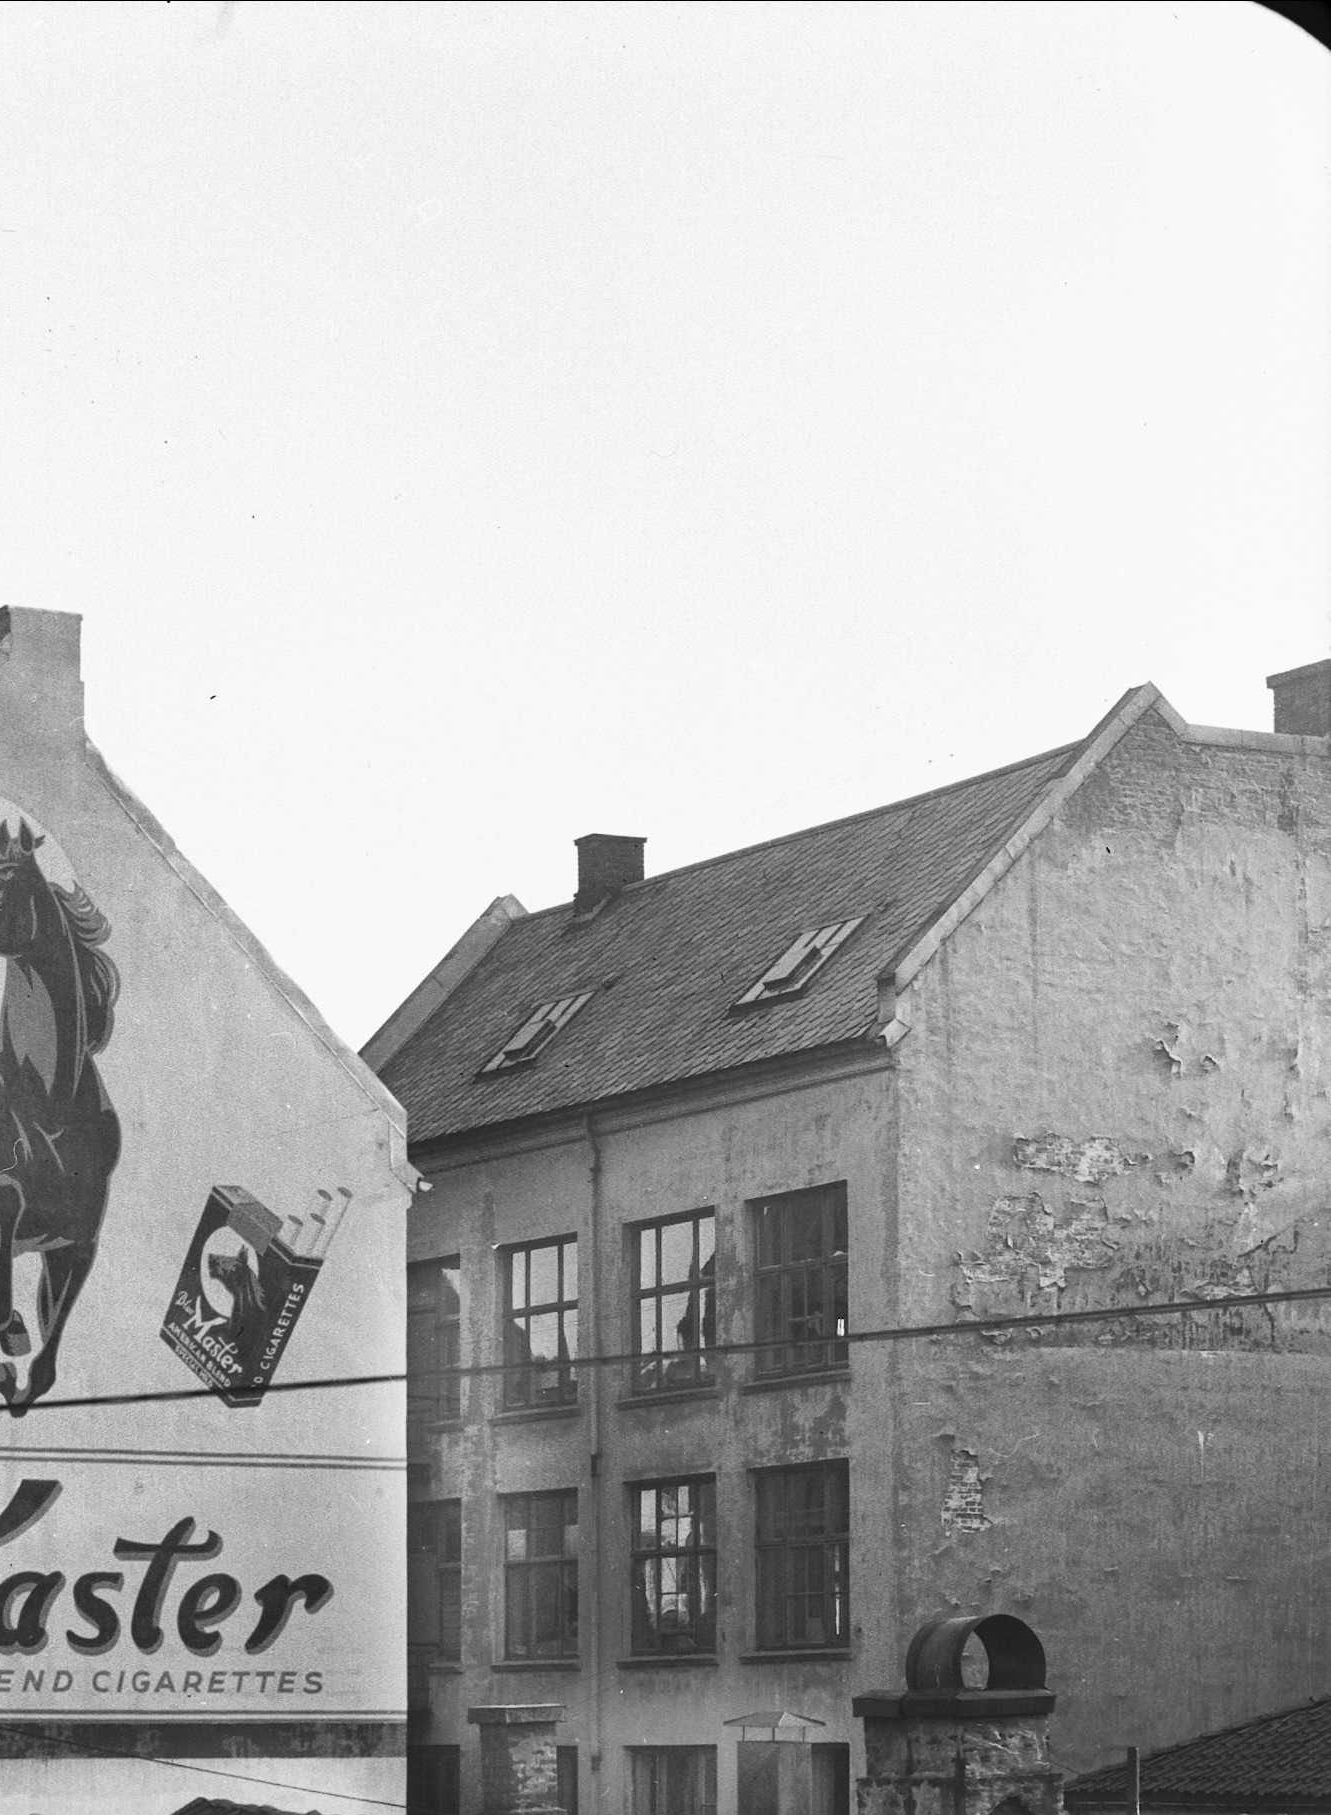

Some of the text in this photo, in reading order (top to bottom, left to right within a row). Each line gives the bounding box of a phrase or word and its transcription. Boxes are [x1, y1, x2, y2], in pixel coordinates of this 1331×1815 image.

[182, 1296, 243, 1377] Master
[260, 1282, 305, 1371] CIGARETTES
[92, 1668, 324, 1695] CIGARETTES
